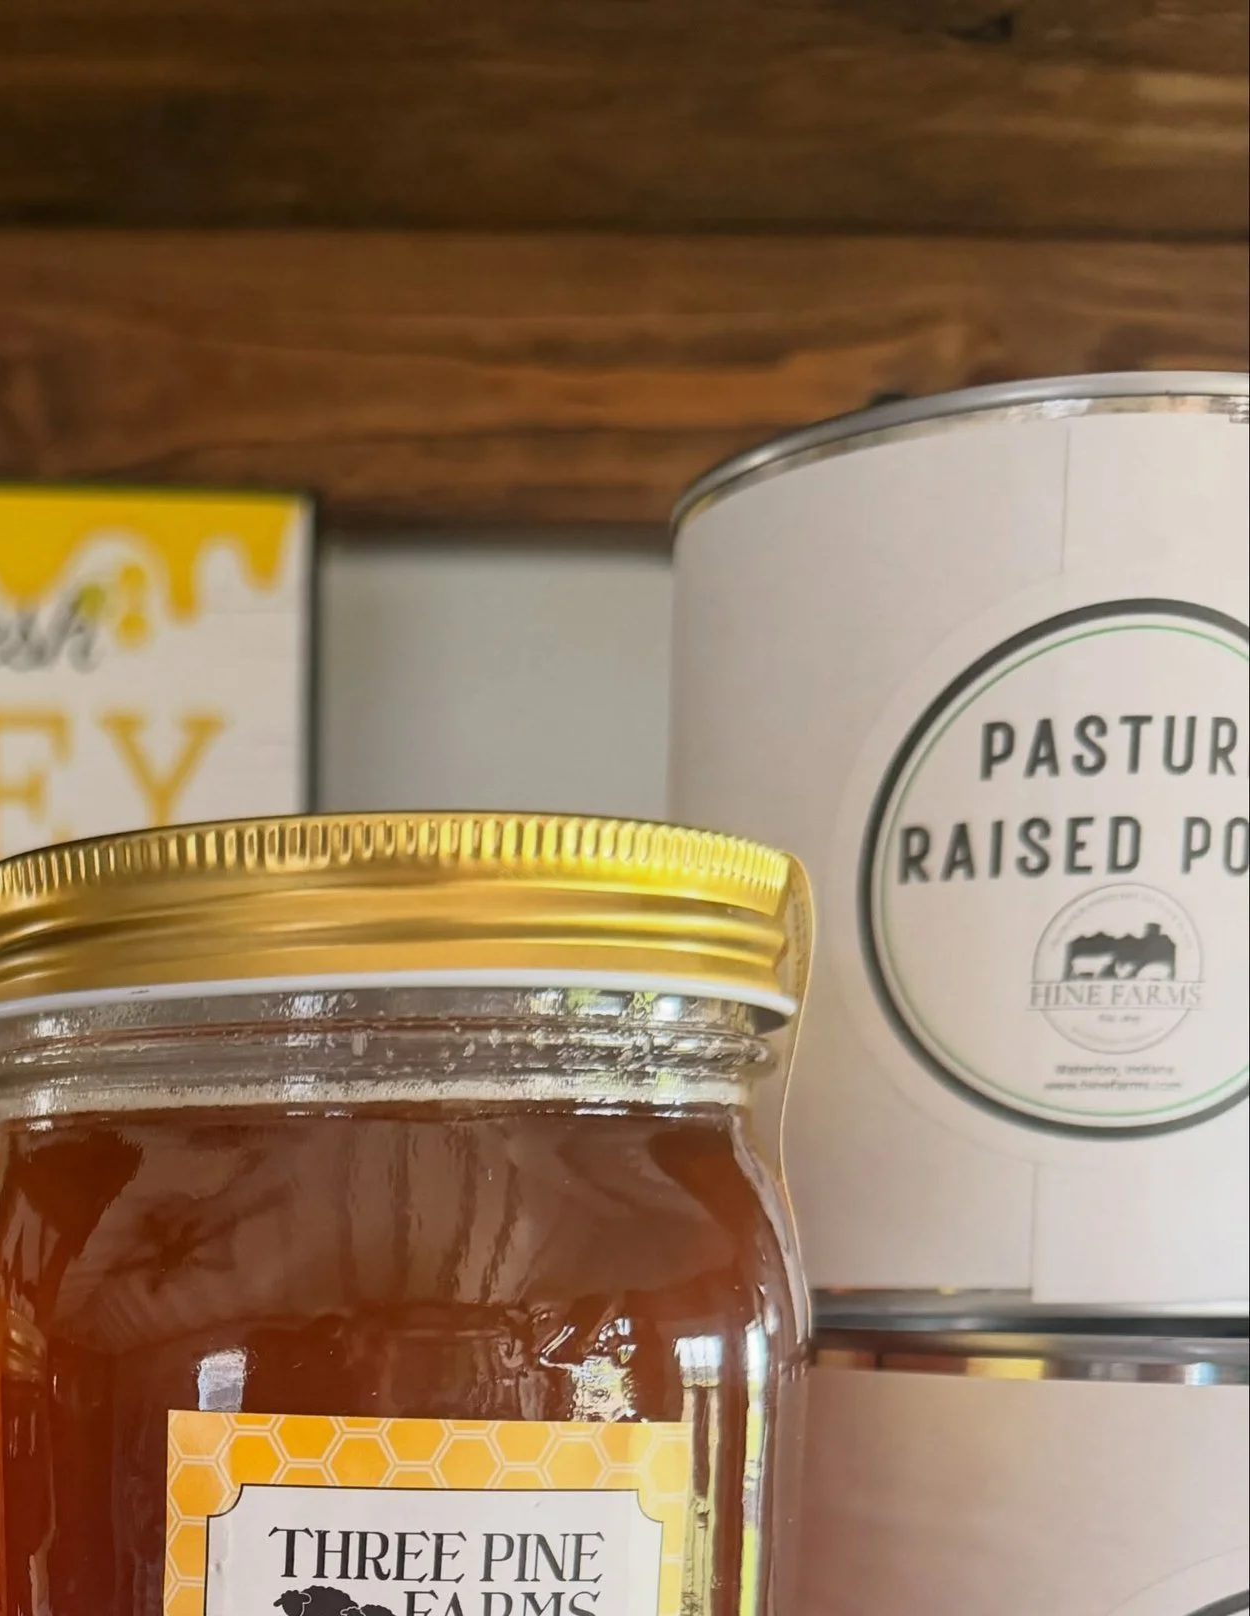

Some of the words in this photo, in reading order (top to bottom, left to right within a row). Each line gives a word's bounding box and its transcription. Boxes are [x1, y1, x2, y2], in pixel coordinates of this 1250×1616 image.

[897, 815, 1143, 886] RAISED
[1180, 815, 1249, 877] PO
[1030, 984, 1104, 1008] HINE
[1111, 984, 1203, 1007] FARMS
[269, 1526, 467, 1584] THREE
[479, 1530, 605, 1584] PINE
